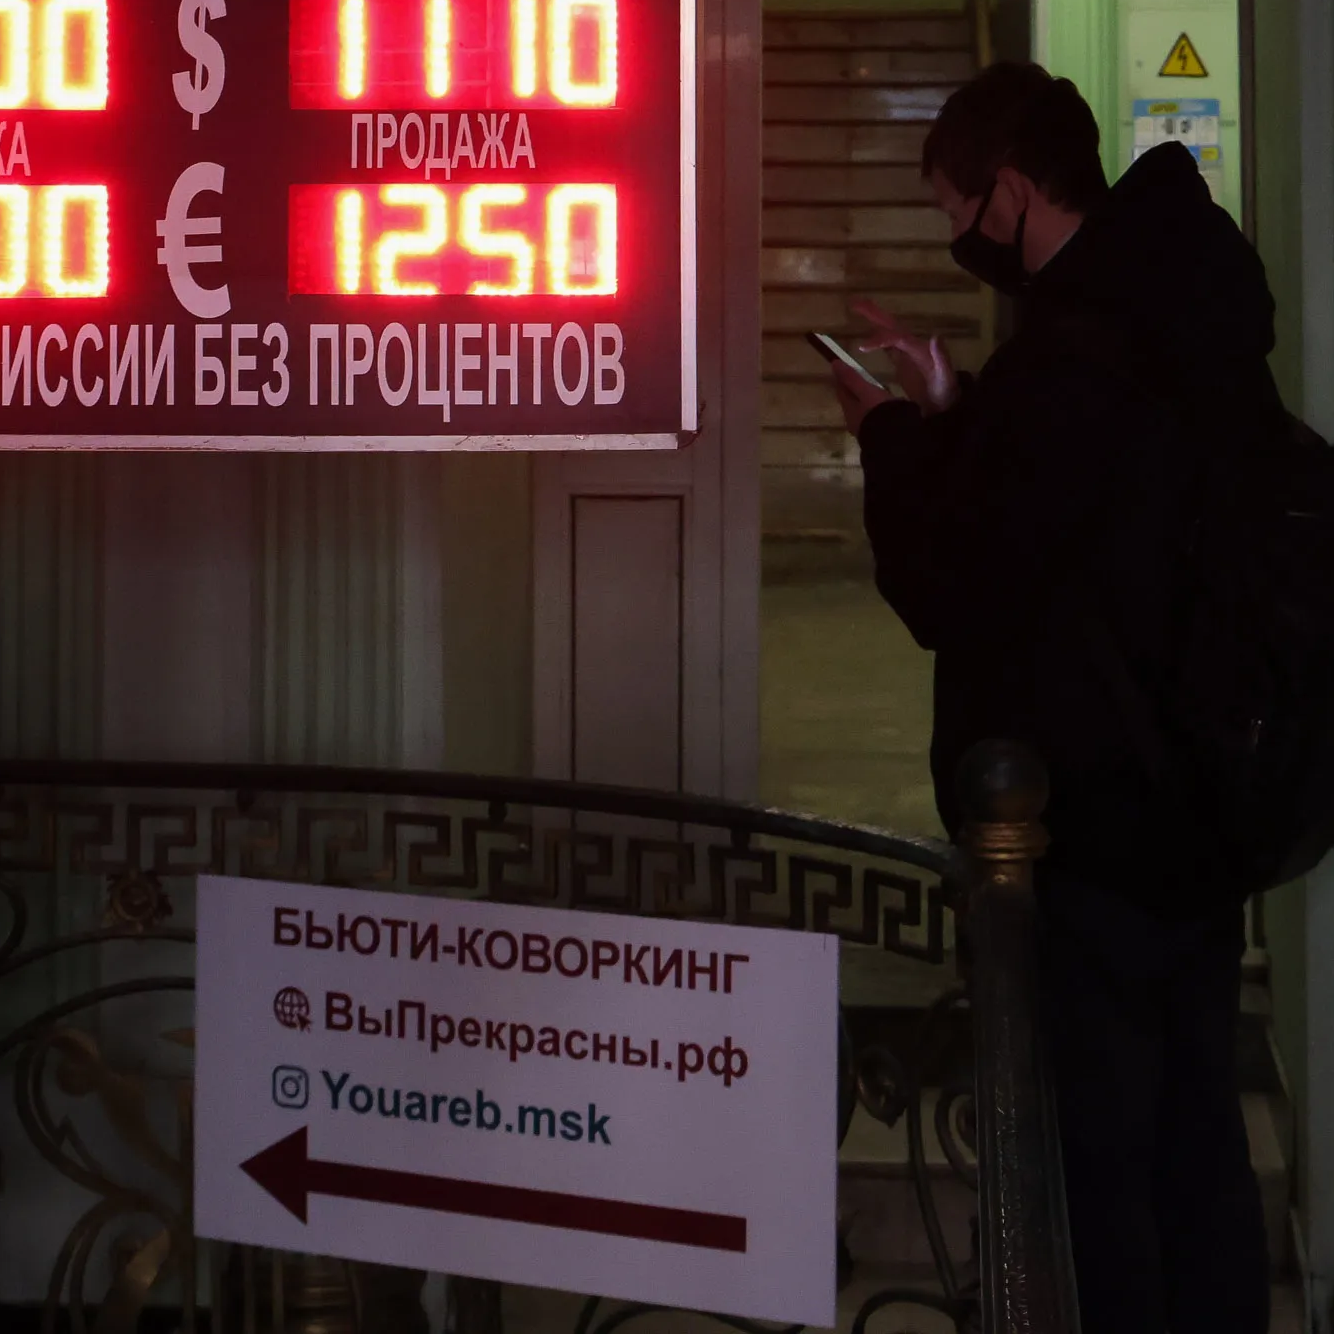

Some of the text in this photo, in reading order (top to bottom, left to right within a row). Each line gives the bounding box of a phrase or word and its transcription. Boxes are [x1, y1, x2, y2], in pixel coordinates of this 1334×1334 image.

[351, 113, 536, 179] ПРОДАЖА
[156, 162, 231, 320] €
[336, 184, 617, 296] 1250
[195, 324, 289, 406] БЕЗ
[310, 322, 624, 422] ПРОЦЕНТОВ
[272, 907, 750, 994] БЬЮТИ-КОВОРКИНГ
[325, 991, 749, 1087] ВыПрекрасны.рф
[321, 1070, 612, 1145] Youareb.msk
